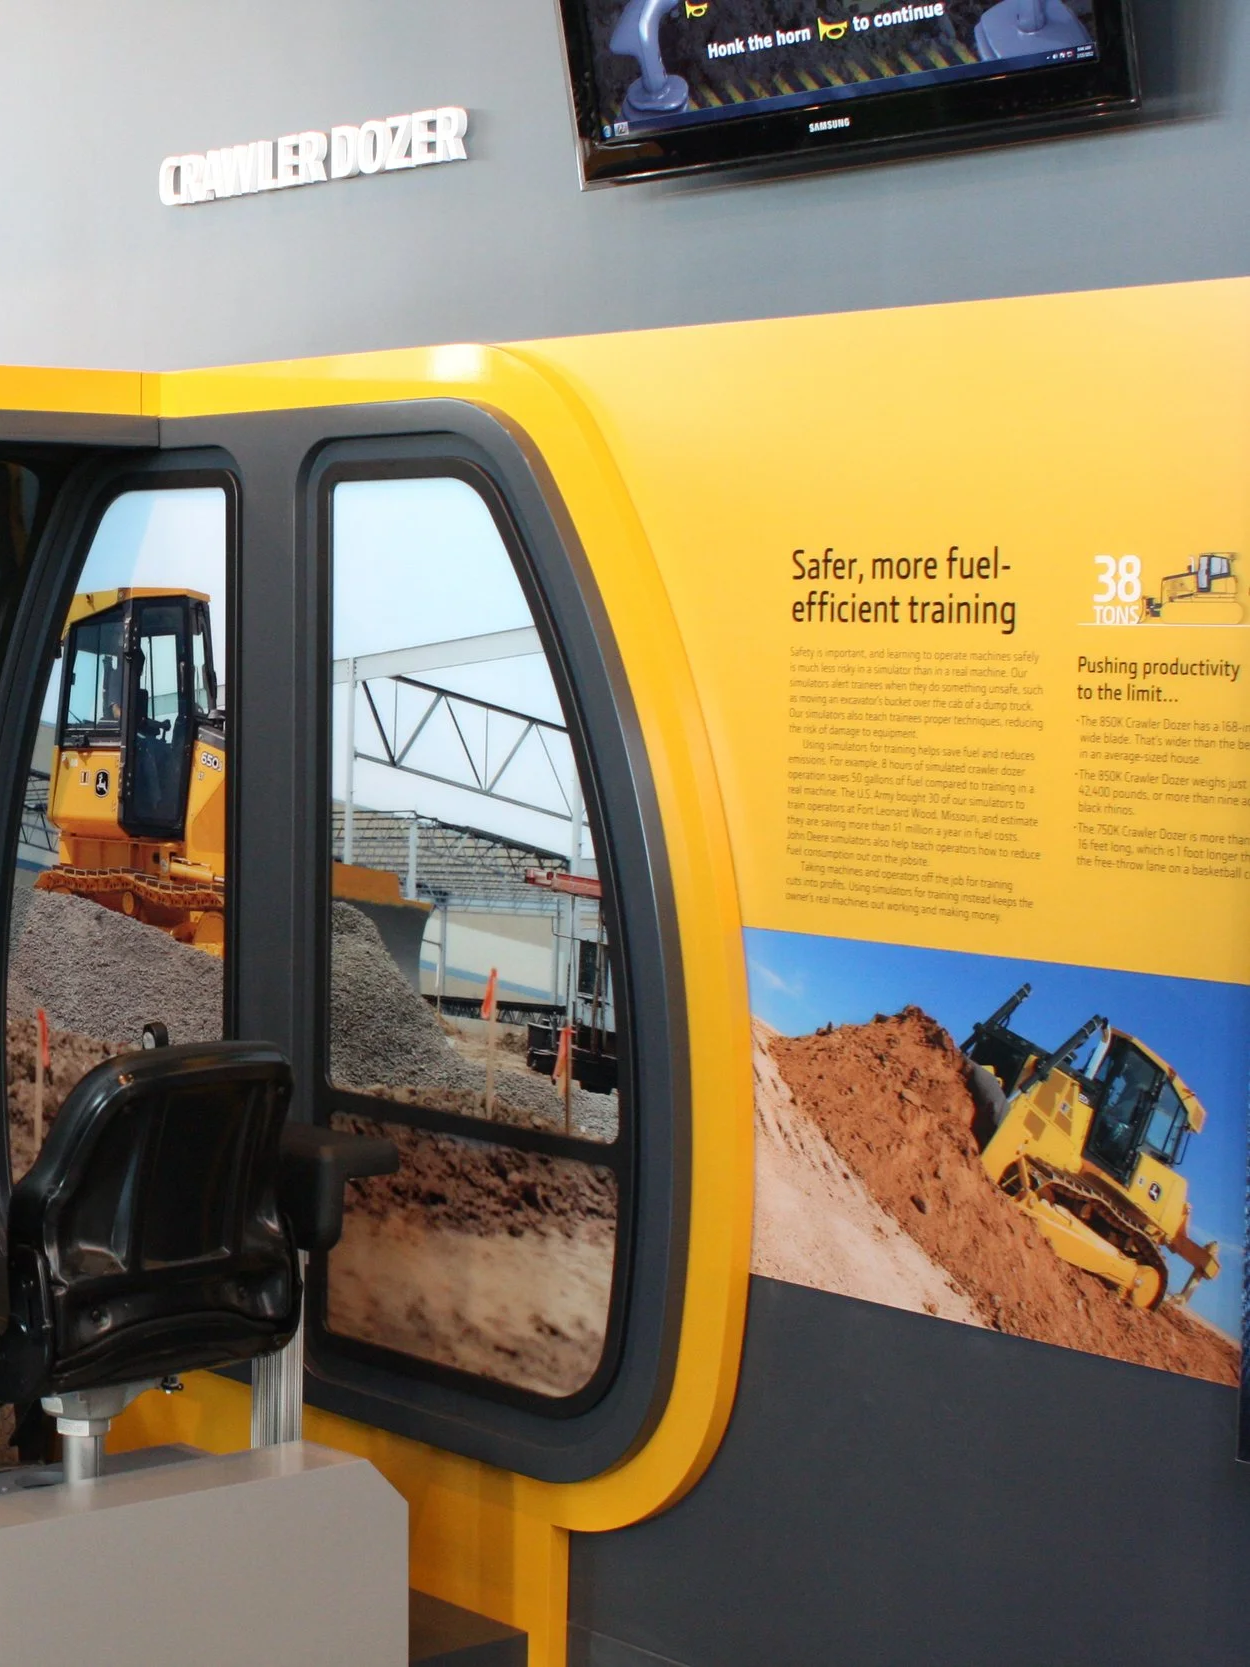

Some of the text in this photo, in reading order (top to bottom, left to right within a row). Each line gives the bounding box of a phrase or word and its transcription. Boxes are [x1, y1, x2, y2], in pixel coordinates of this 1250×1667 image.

[707, 2, 944, 59] Honk the horn to continue
[808, 117, 850, 133] SAMSUNG
[159, 106, 468, 206] CRAWLER DOZER
[791, 546, 1011, 583] Safer, more fuel-
[1093, 554, 1142, 603] 38
[791, 591, 1016, 634] efficient training
[1094, 605, 1140, 625] TONS
[1077, 656, 1240, 682] Pushing productivity
[1077, 683, 1178, 702] to the limit...
[1080, 714, 1097, 727] The
[1099, 715, 1122, 728] 850K
[1125, 716, 1161, 729] Crawler
[1163, 718, 1191, 730] Dozer
[1193, 719, 1210, 731] has
[1080, 730, 1101, 743] wide
[1134, 733, 1162, 746] That's
[1165, 734, 1191, 747] wider
[1193, 736, 1216, 748] than
[1218, 737, 1236, 749] the
[1104, 748, 1168, 766] average-sized
[1079, 768, 1247, 792] The 850K Crawler Dozer weighs just
[1078, 800, 1102, 814] black
[1165, 793, 1190, 803] more
[1192, 791, 1214, 804] than
[1217, 793, 1239, 806] nine
[1077, 821, 1094, 834] The
[1096, 823, 1119, 836] 750K
[1122, 824, 1157, 839] Crawler
[1159, 827, 1187, 841] Dozer
[1199, 834, 1225, 844] more
[1089, 838, 1108, 852] feet
[1136, 842, 1164, 856] which
[1183, 846, 1204, 859] foot
[1206, 848, 1238, 865] longer
[1076, 854, 1092, 867] the
[1094, 855, 1144, 871] free-throw
[1146, 859, 1166, 873] lane
[1191, 863, 1241, 879] basketball
